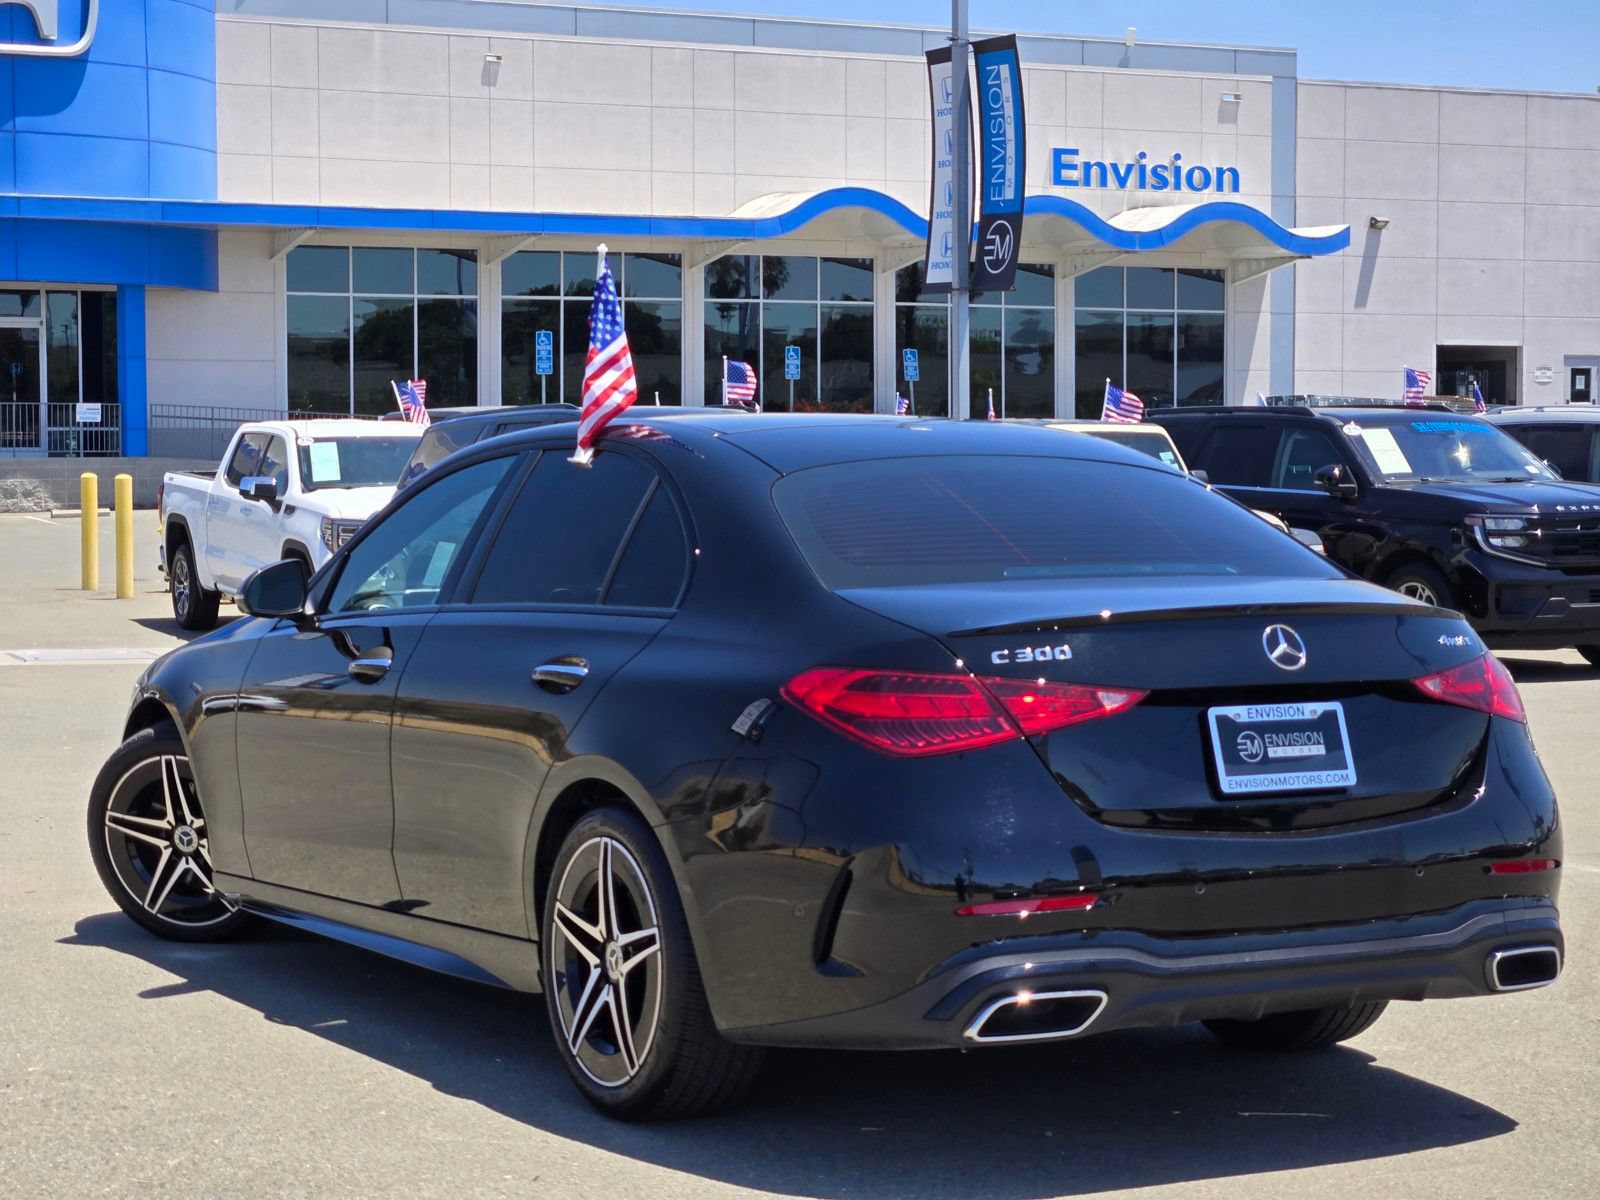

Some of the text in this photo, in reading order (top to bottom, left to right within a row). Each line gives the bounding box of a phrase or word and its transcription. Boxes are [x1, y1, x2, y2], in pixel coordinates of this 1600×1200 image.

[985, 65, 1006, 201] ENVISION
[1052, 147, 1240, 193] Envision
[991, 644, 1073, 664] C 300
[1246, 705, 1305, 720] ENVISION
[1264, 731, 1325, 747] ENVISION
[1227, 773, 1350, 790] ENVISIONMOTORS.COM
